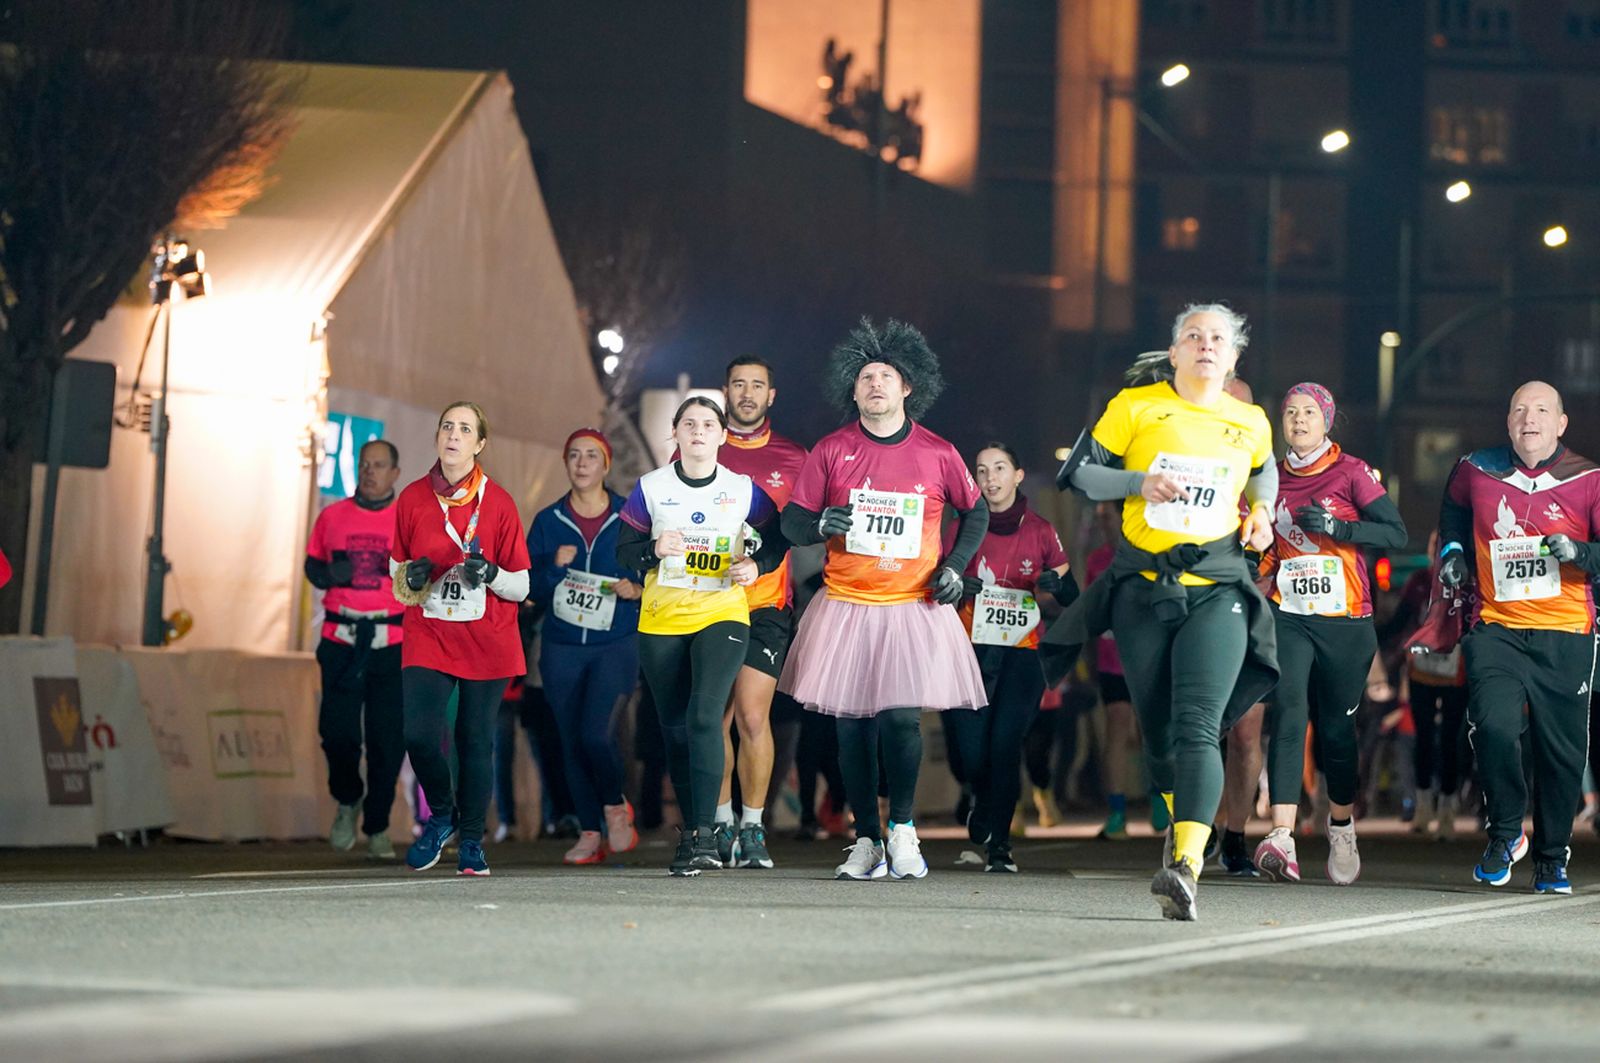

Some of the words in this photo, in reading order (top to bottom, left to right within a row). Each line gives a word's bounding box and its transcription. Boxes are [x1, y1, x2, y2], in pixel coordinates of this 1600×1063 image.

[866, 498, 888, 506] NOCHE
[1169, 486, 1216, 508] 479
[857, 504, 873, 513] SAN
[866, 514, 905, 536] 7170
[1288, 530, 1304, 546] 43
[1505, 559, 1547, 579] 2573
[1291, 576, 1332, 596] 1368
[566, 589, 603, 611] 3427
[985, 607, 1028, 627] 2955
